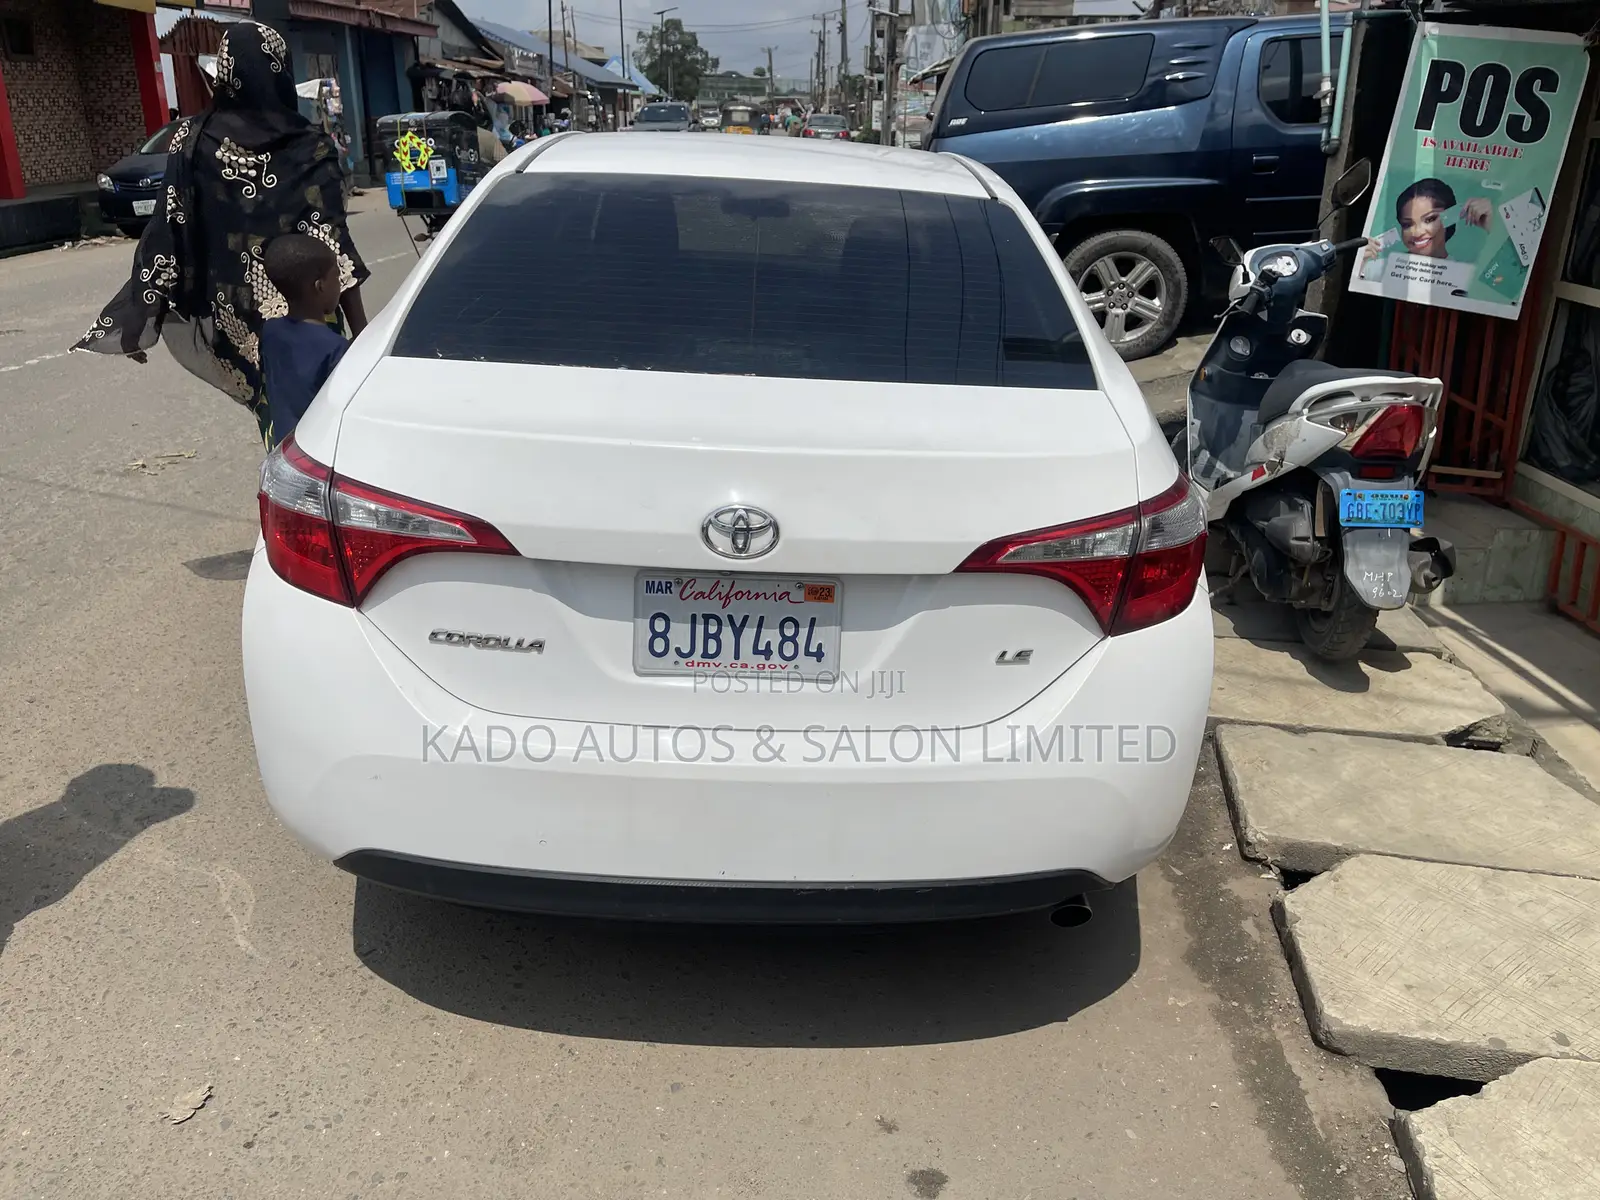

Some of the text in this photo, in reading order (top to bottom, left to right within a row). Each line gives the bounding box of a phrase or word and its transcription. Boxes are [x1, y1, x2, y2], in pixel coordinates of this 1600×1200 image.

[1413, 58, 1560, 145] POS
[1421, 136, 1525, 159] IS AVAILABLE
[1444, 156, 1491, 172] HERE
[1390, 271, 1402, 279] Get
[1419, 276, 1435, 284] Card
[645, 580, 673, 595] MAR
[679, 578, 804, 609] California
[819, 586, 830, 597] 23
[428, 628, 546, 654] COROLLA
[648, 612, 825, 663] 8JBY484
[685, 660, 788, 671] dmv.ca.gov
[995, 649, 1034, 665] LE
